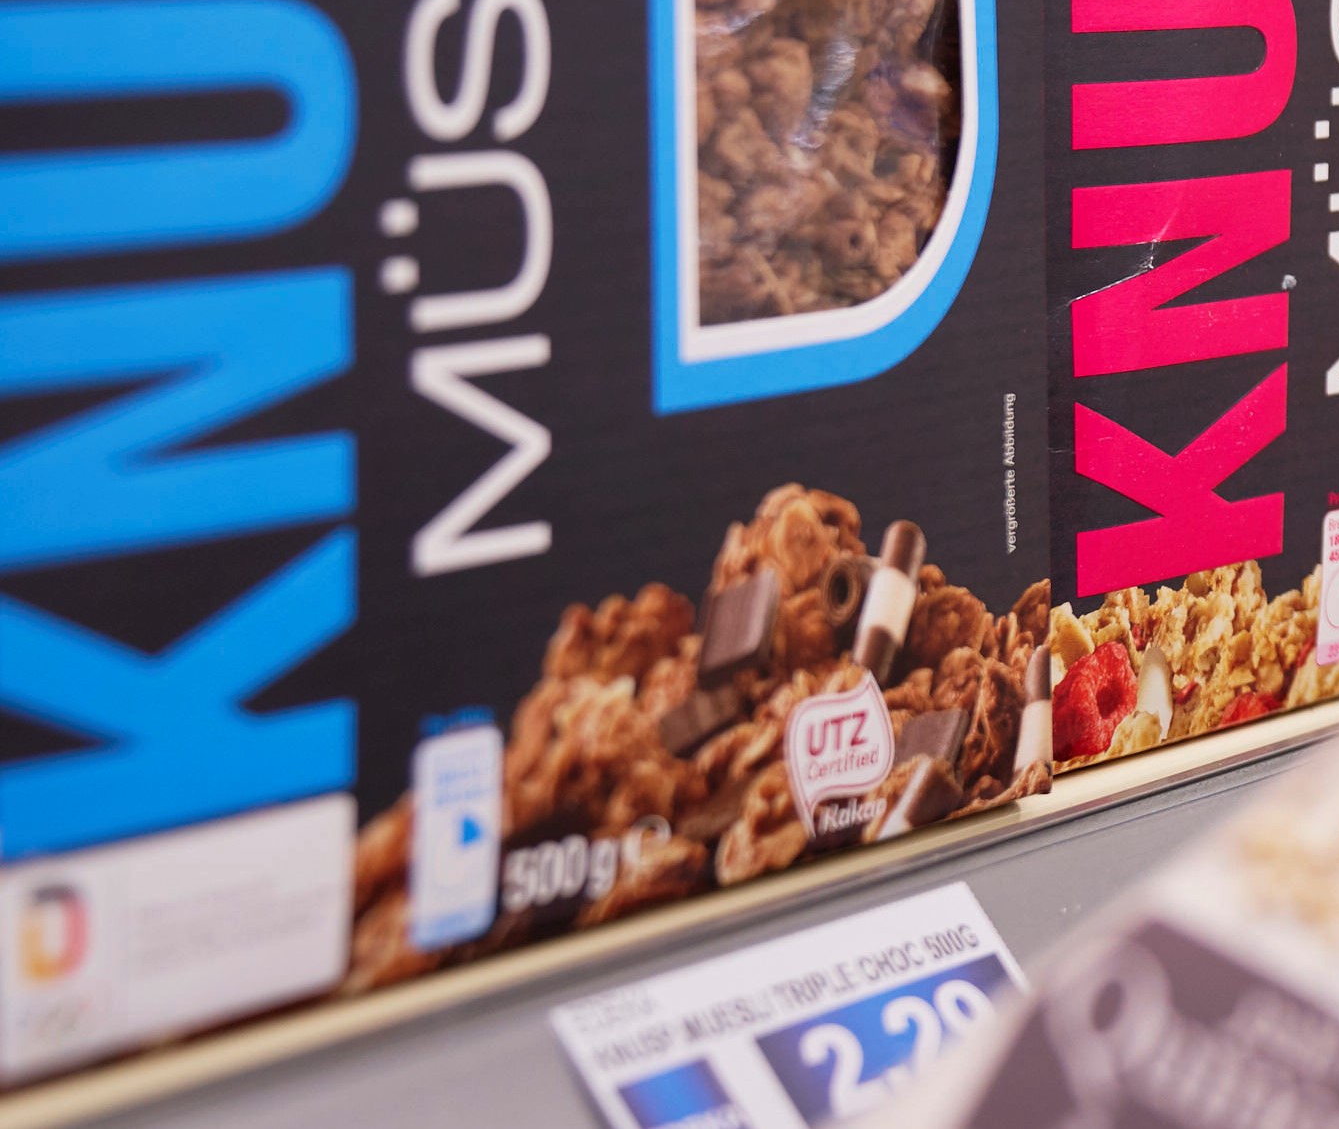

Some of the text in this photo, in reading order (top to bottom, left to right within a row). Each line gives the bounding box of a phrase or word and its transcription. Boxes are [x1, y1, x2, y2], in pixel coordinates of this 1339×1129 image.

[1002, 392, 1017, 467] Abbildung
[807, 709, 869, 757] UTZ
[807, 745, 881, 781] Certified
[817, 797, 888, 836] Kakao
[770, 961, 858, 1009] TRIPLE
[859, 935, 926, 982] CHOC
[921, 923, 979, 961] 500G
